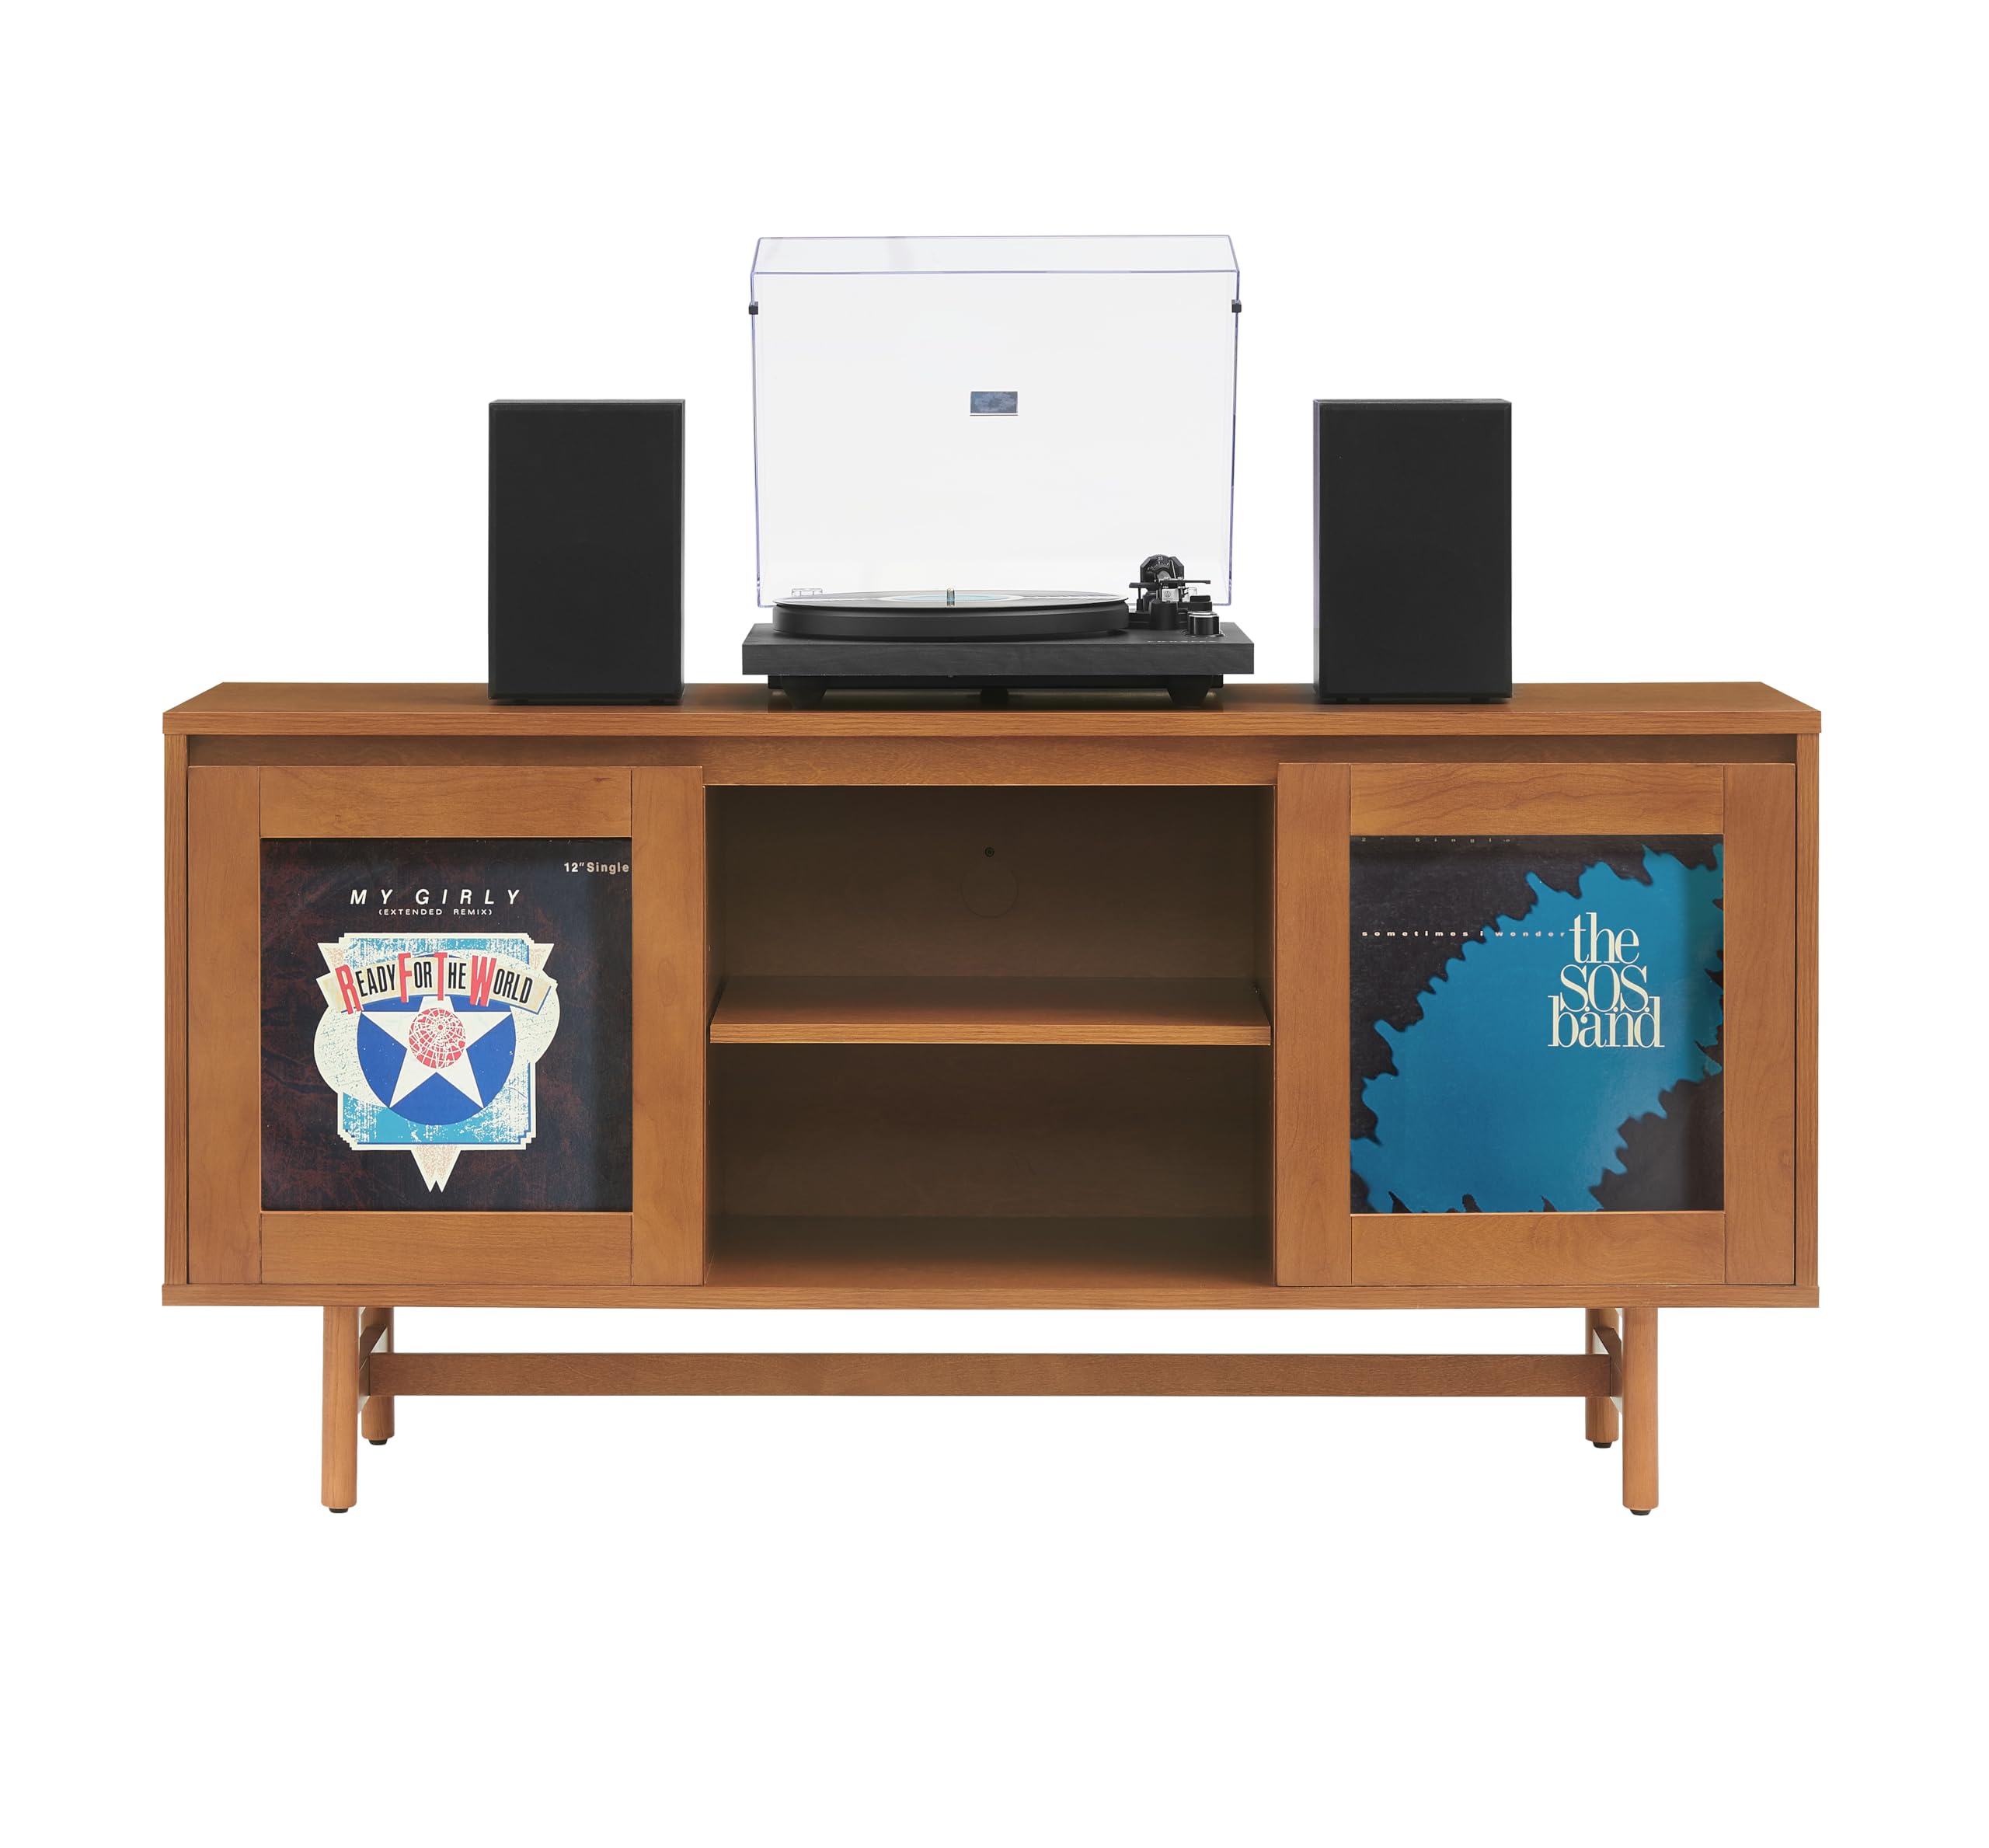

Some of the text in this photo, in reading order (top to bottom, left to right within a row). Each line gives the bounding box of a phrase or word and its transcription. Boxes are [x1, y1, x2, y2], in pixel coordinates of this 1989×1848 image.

[350, 888, 520, 905] MY GIRLY
[1569, 912, 1640, 964] the
[335, 952, 534, 1015] READY FOR THE WORLD
[1548, 995, 1665, 1048] band
